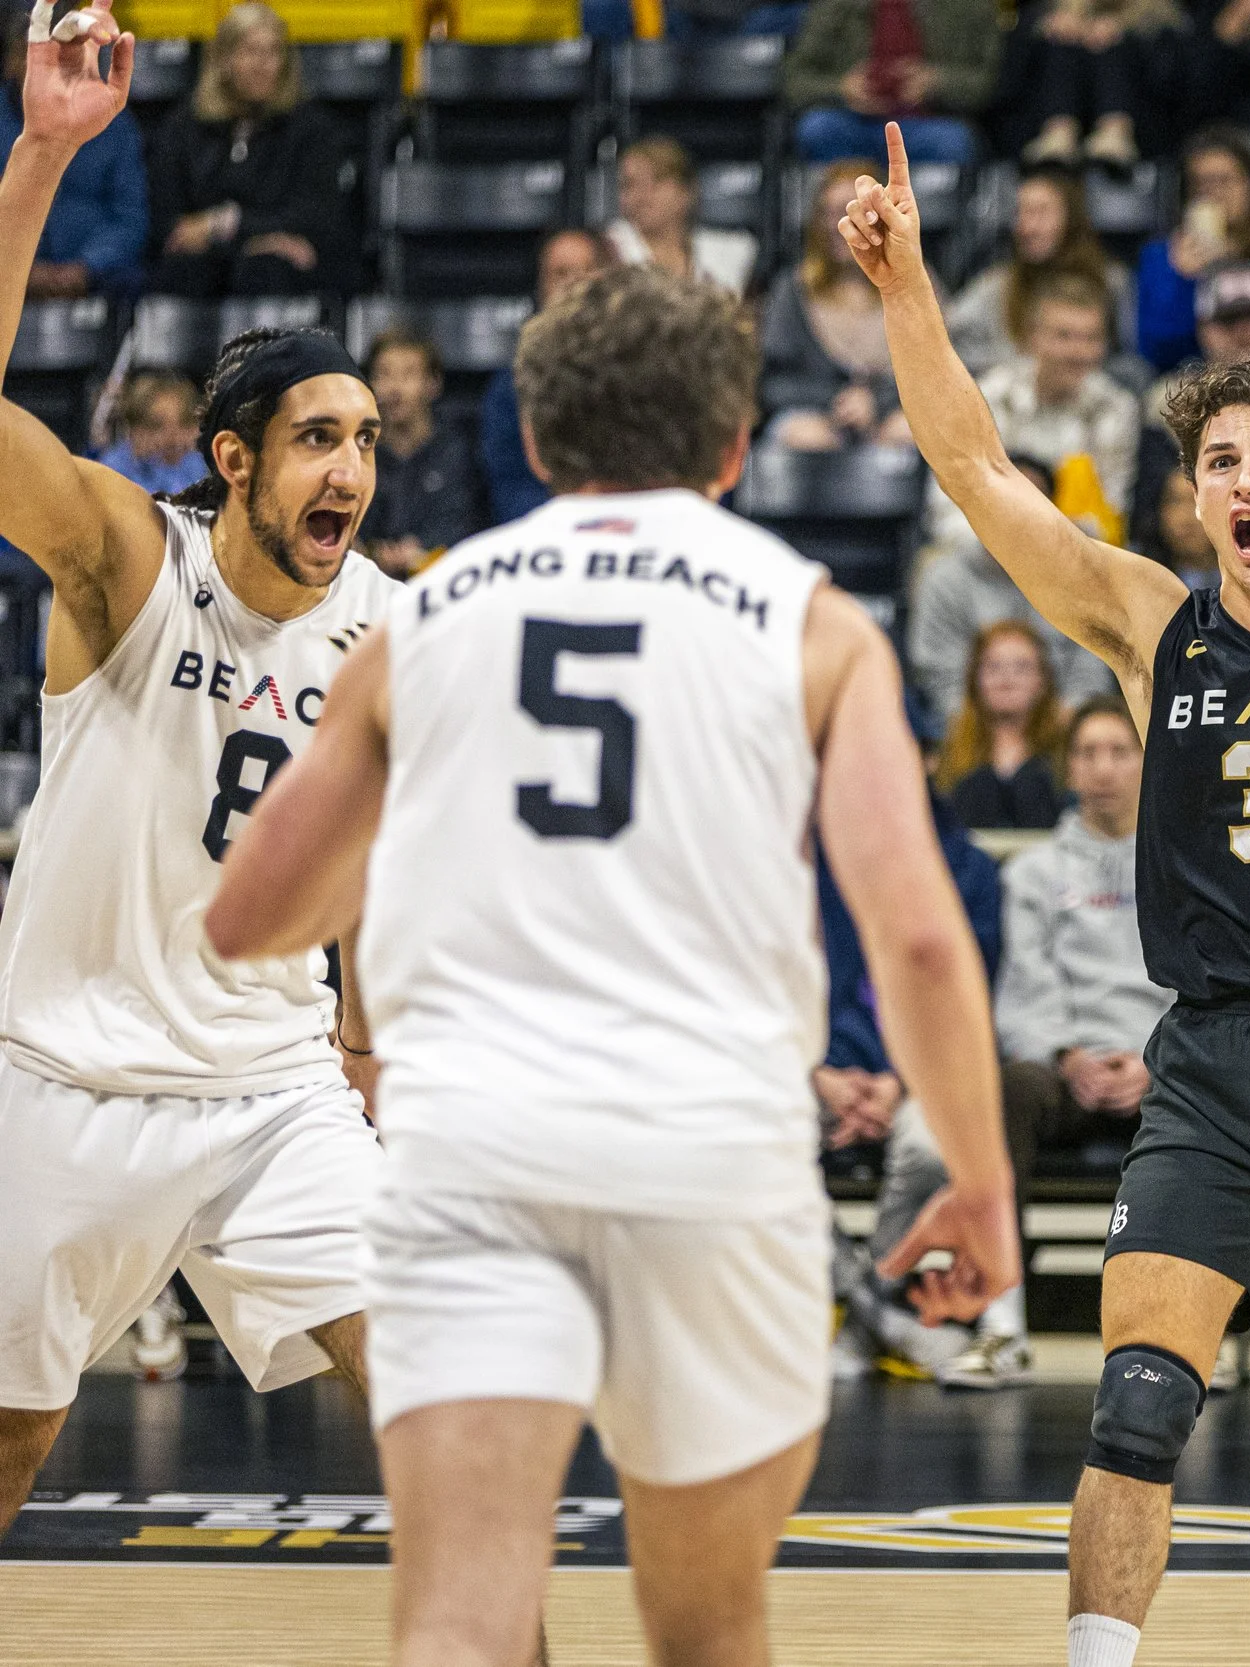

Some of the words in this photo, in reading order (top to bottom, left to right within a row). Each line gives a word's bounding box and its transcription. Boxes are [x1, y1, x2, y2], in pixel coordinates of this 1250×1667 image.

[418, 548, 564, 620] LONG
[584, 550, 771, 630] BEACH
[170, 650, 327, 727] BEAC
[517, 617, 642, 840] 5
[1140, 1369, 1173, 1388] asics
